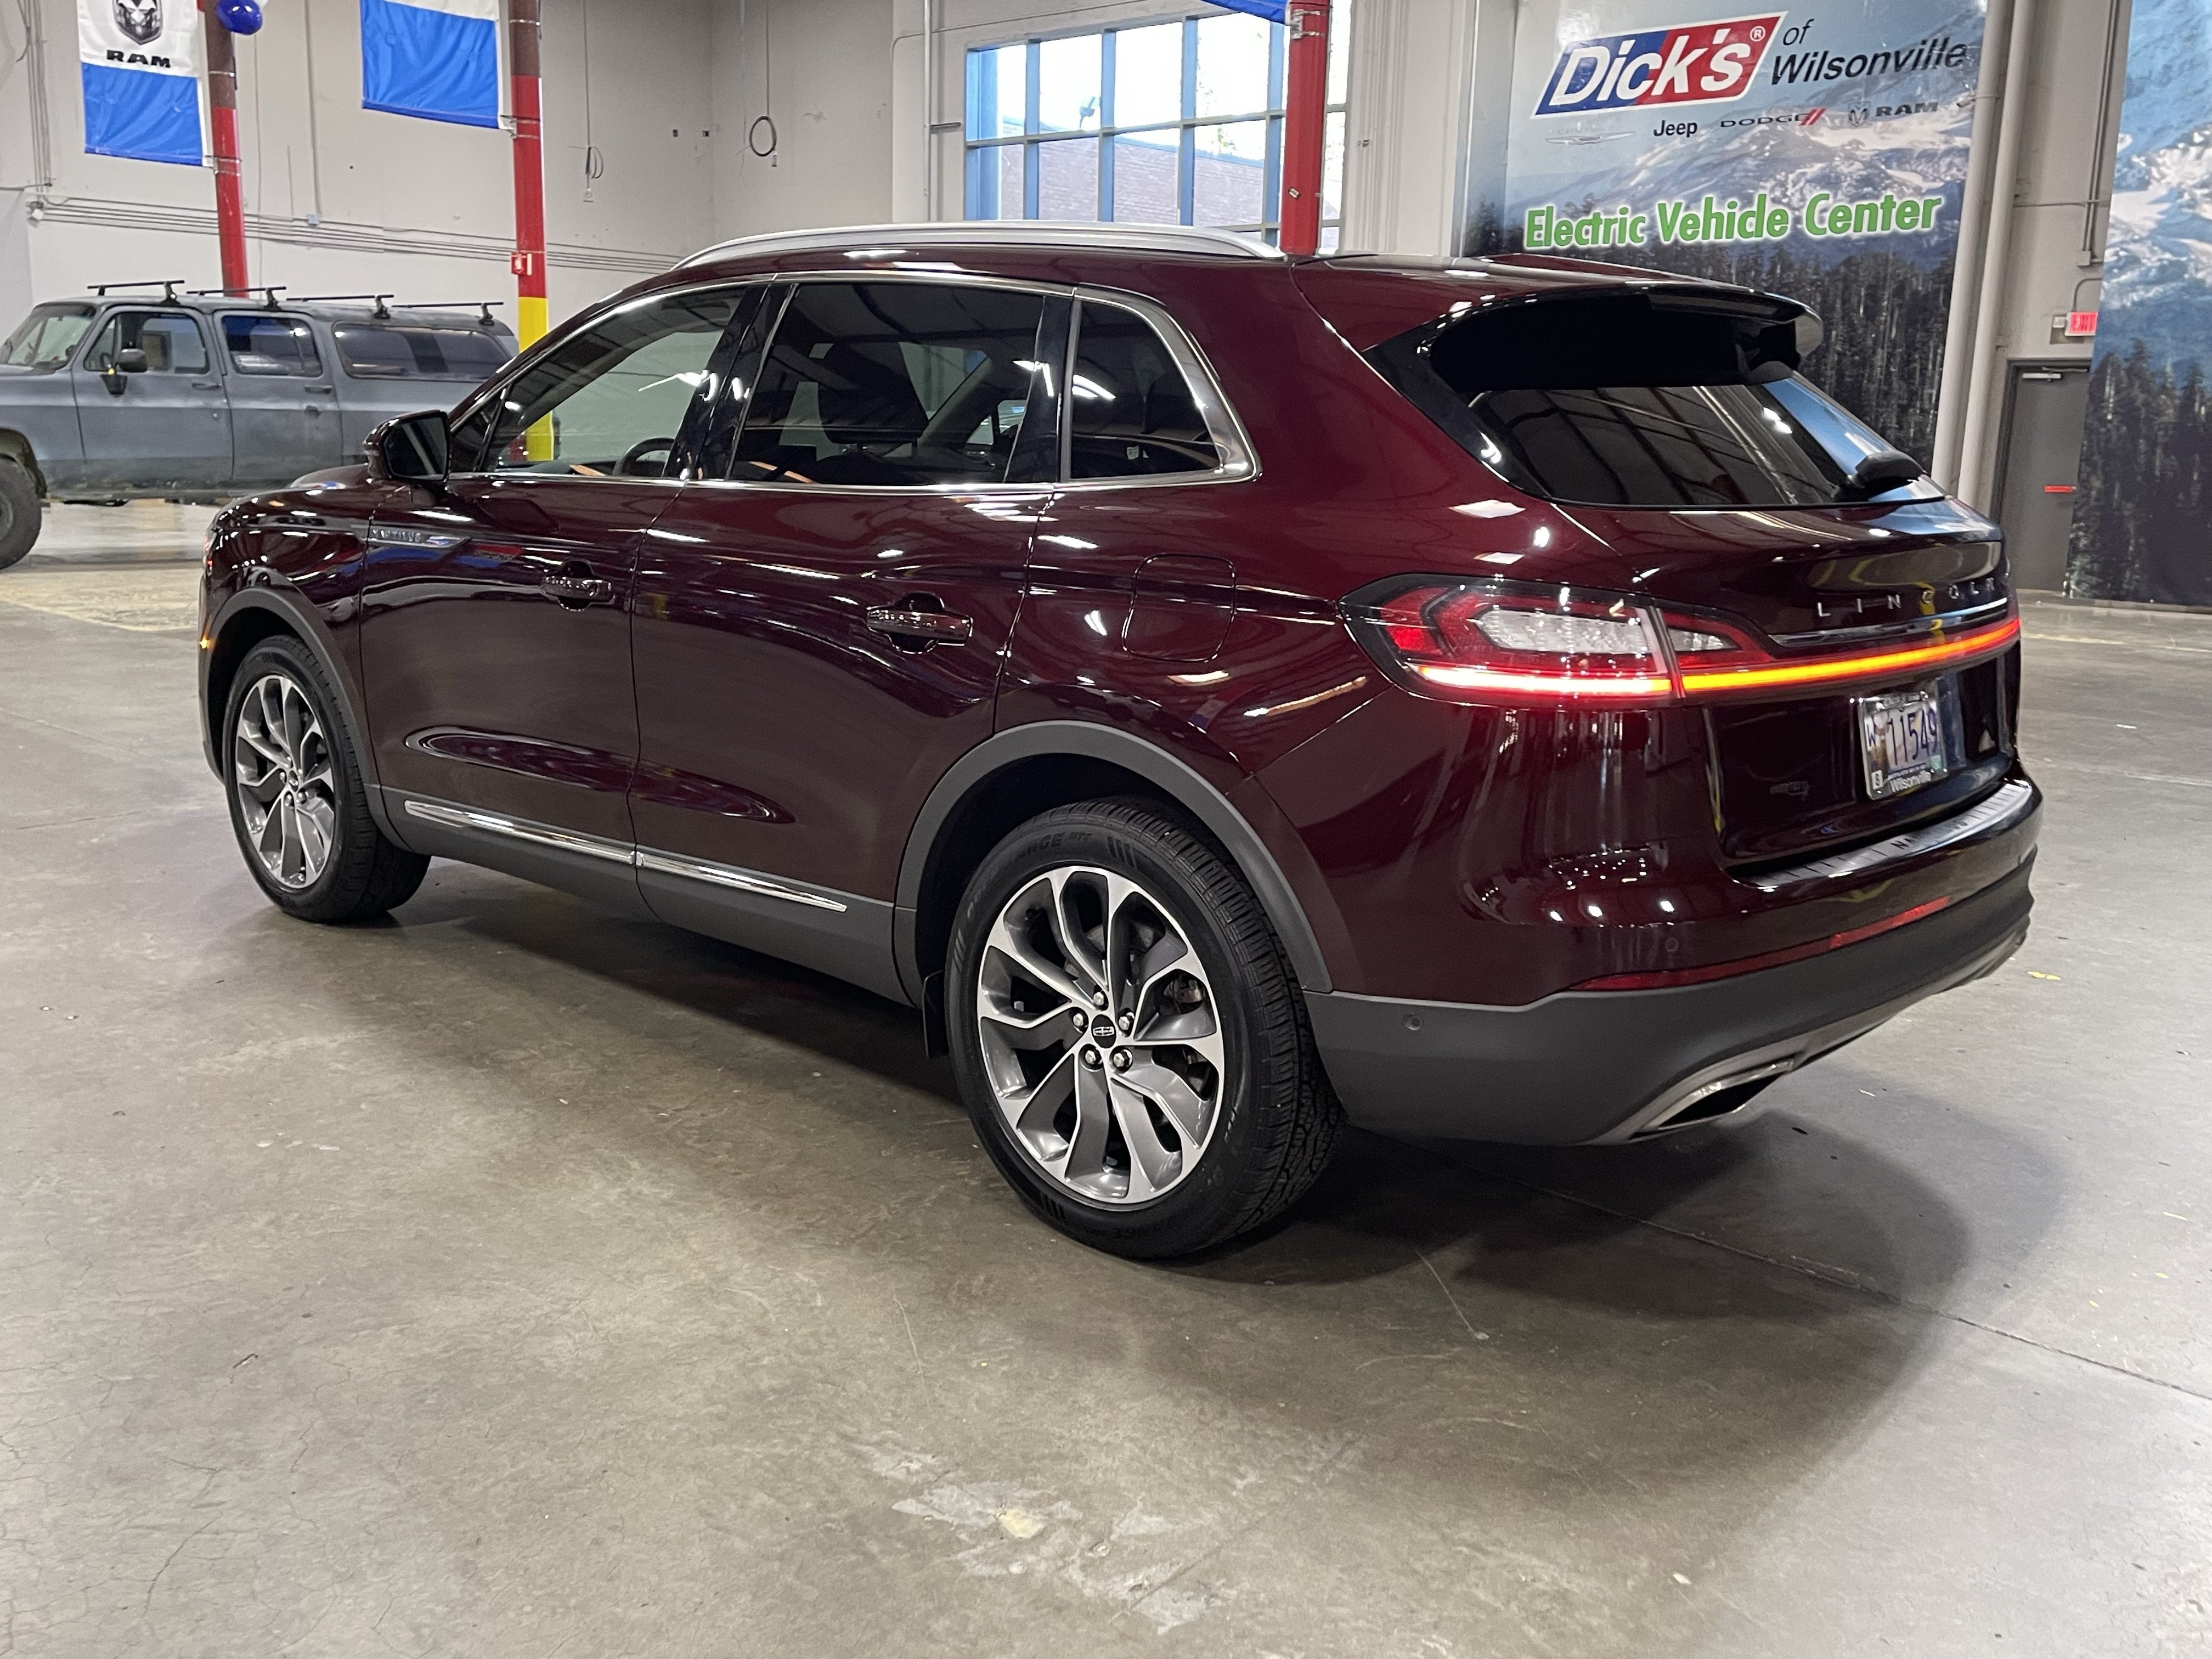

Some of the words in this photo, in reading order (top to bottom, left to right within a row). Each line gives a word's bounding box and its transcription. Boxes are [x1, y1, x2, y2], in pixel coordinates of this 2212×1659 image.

[1782, 19, 1814, 46] of
[106, 49, 171, 68] RAM
[1771, 37, 1967, 85] Wilsonville
[1720, 113, 1810, 127] DODGE
[1876, 102, 1938, 116] RAM
[1654, 120, 1698, 137] Jeep
[1526, 205, 1646, 248] Electric
[1657, 194, 1789, 242] Vehicle
[1805, 193, 1942, 235] Center
[1817, 578, 1995, 618] LINCOLN
